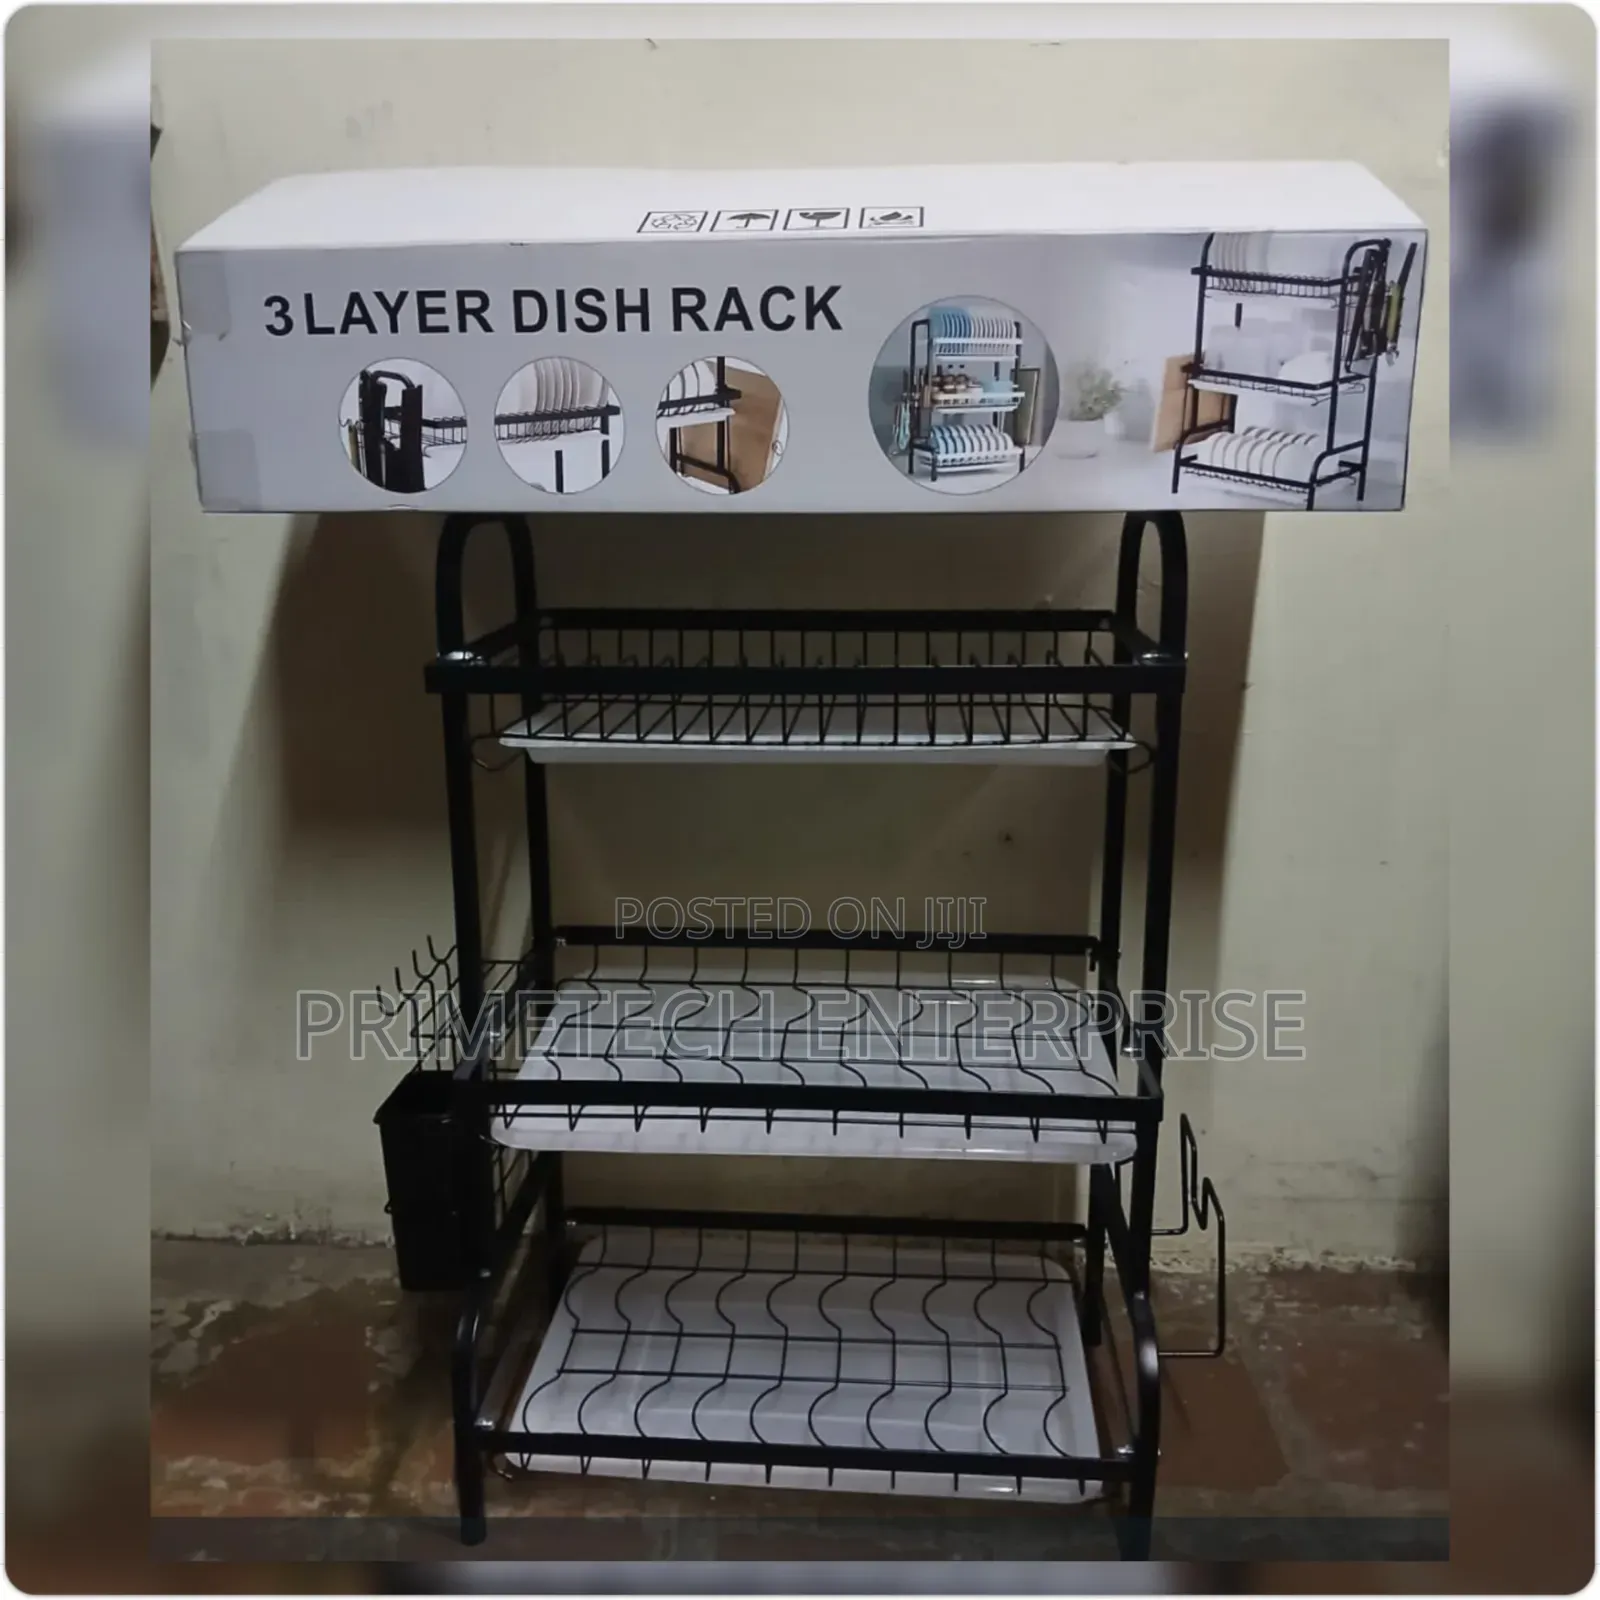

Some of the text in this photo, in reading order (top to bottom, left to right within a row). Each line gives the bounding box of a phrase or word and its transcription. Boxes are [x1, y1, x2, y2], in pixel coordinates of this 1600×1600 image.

[264, 285, 843, 337] 3 LAYER DISH RACK
